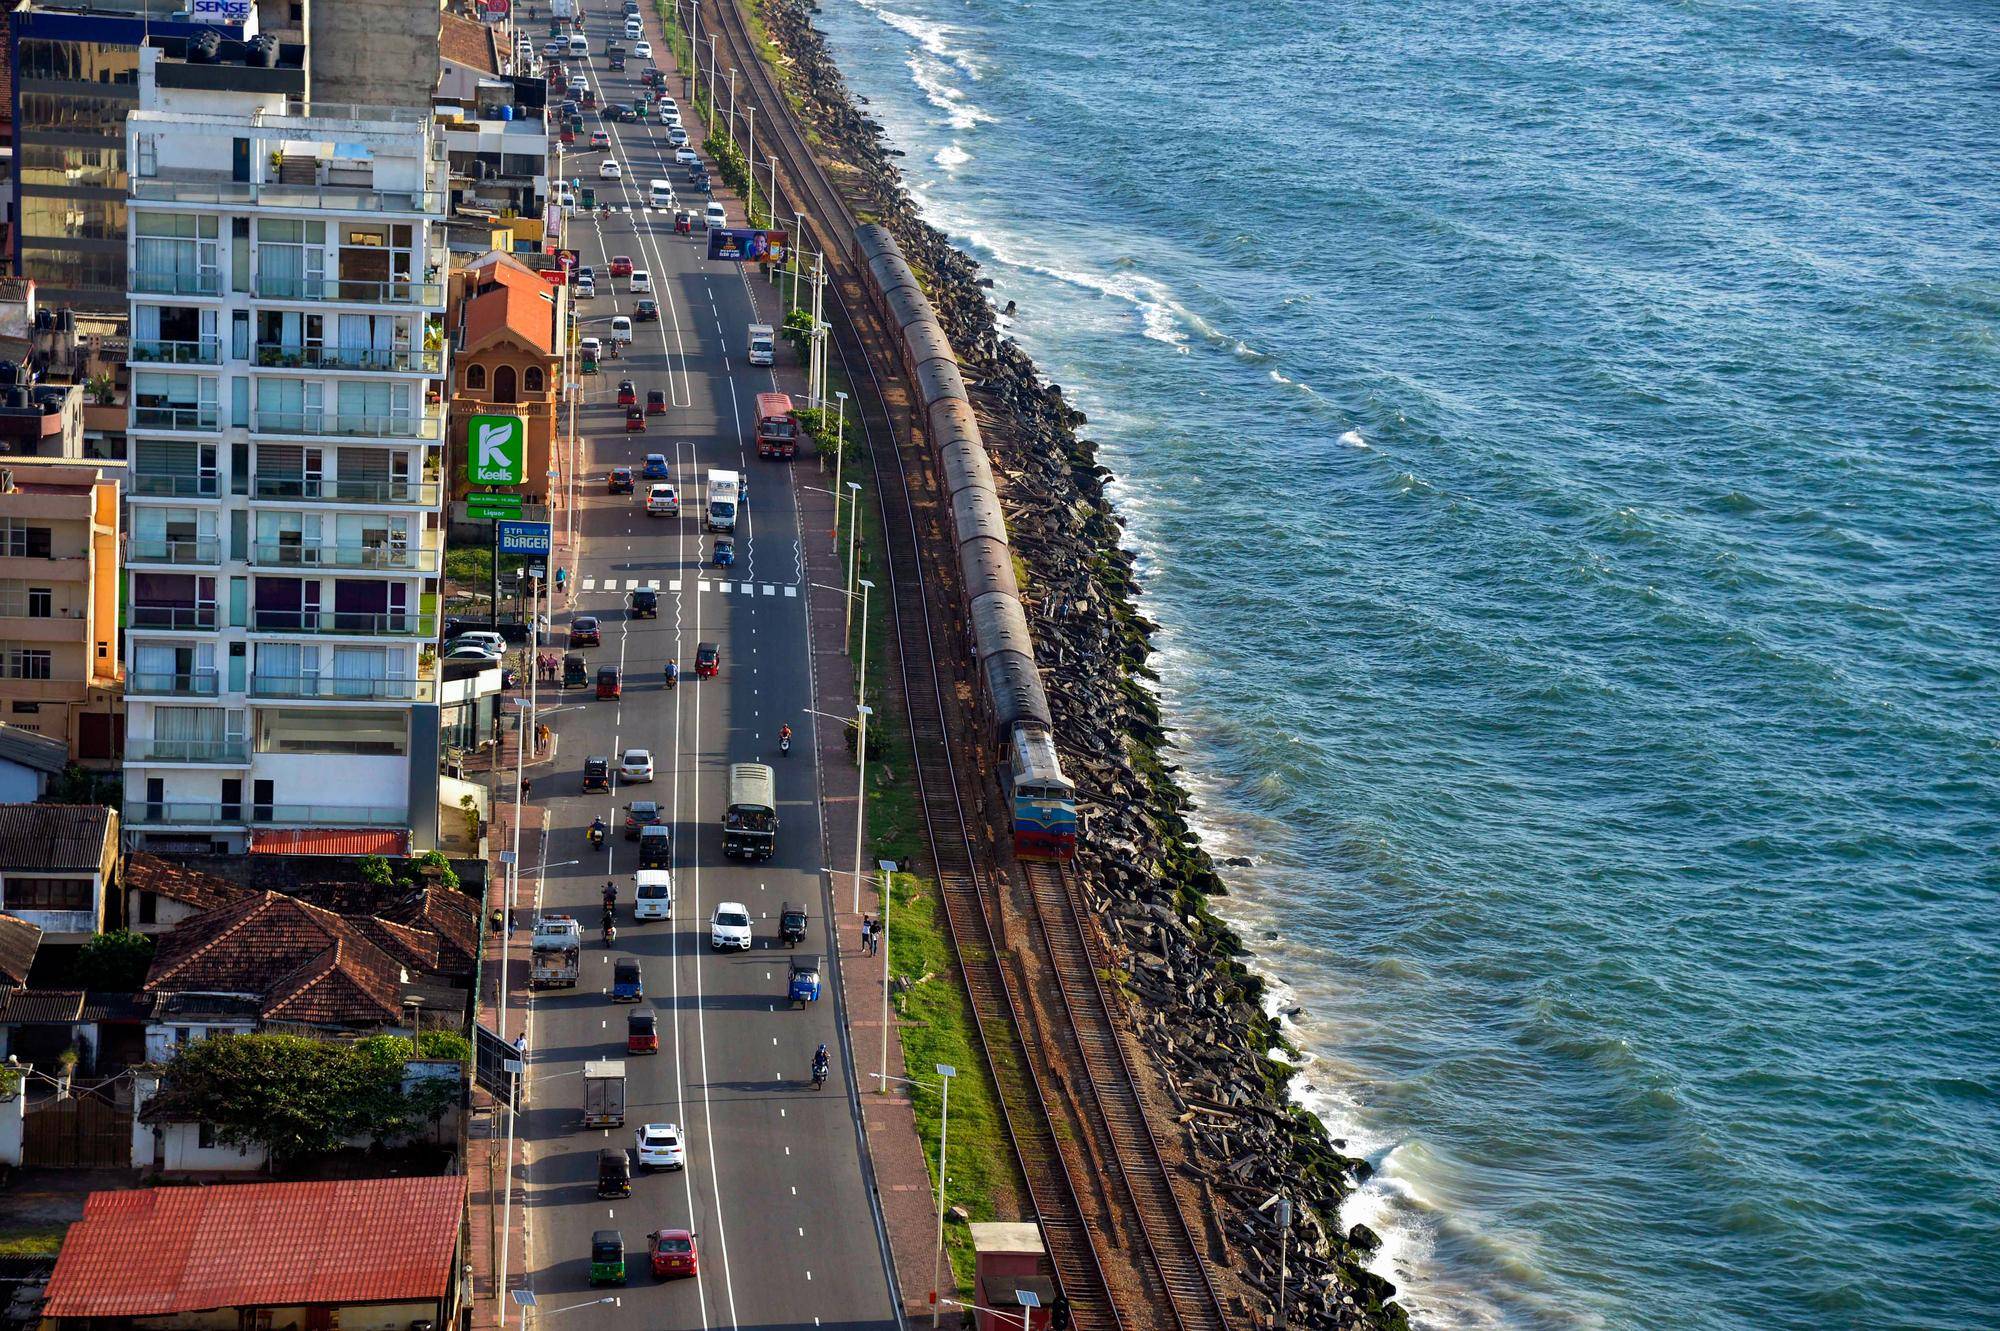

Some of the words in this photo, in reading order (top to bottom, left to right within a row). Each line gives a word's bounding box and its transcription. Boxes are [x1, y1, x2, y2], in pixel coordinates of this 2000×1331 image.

[196, 2, 248, 13] SENSE
[478, 467, 513, 480] Keells
[483, 509, 505, 517] Liquor
[503, 536, 549, 549] BURGER
